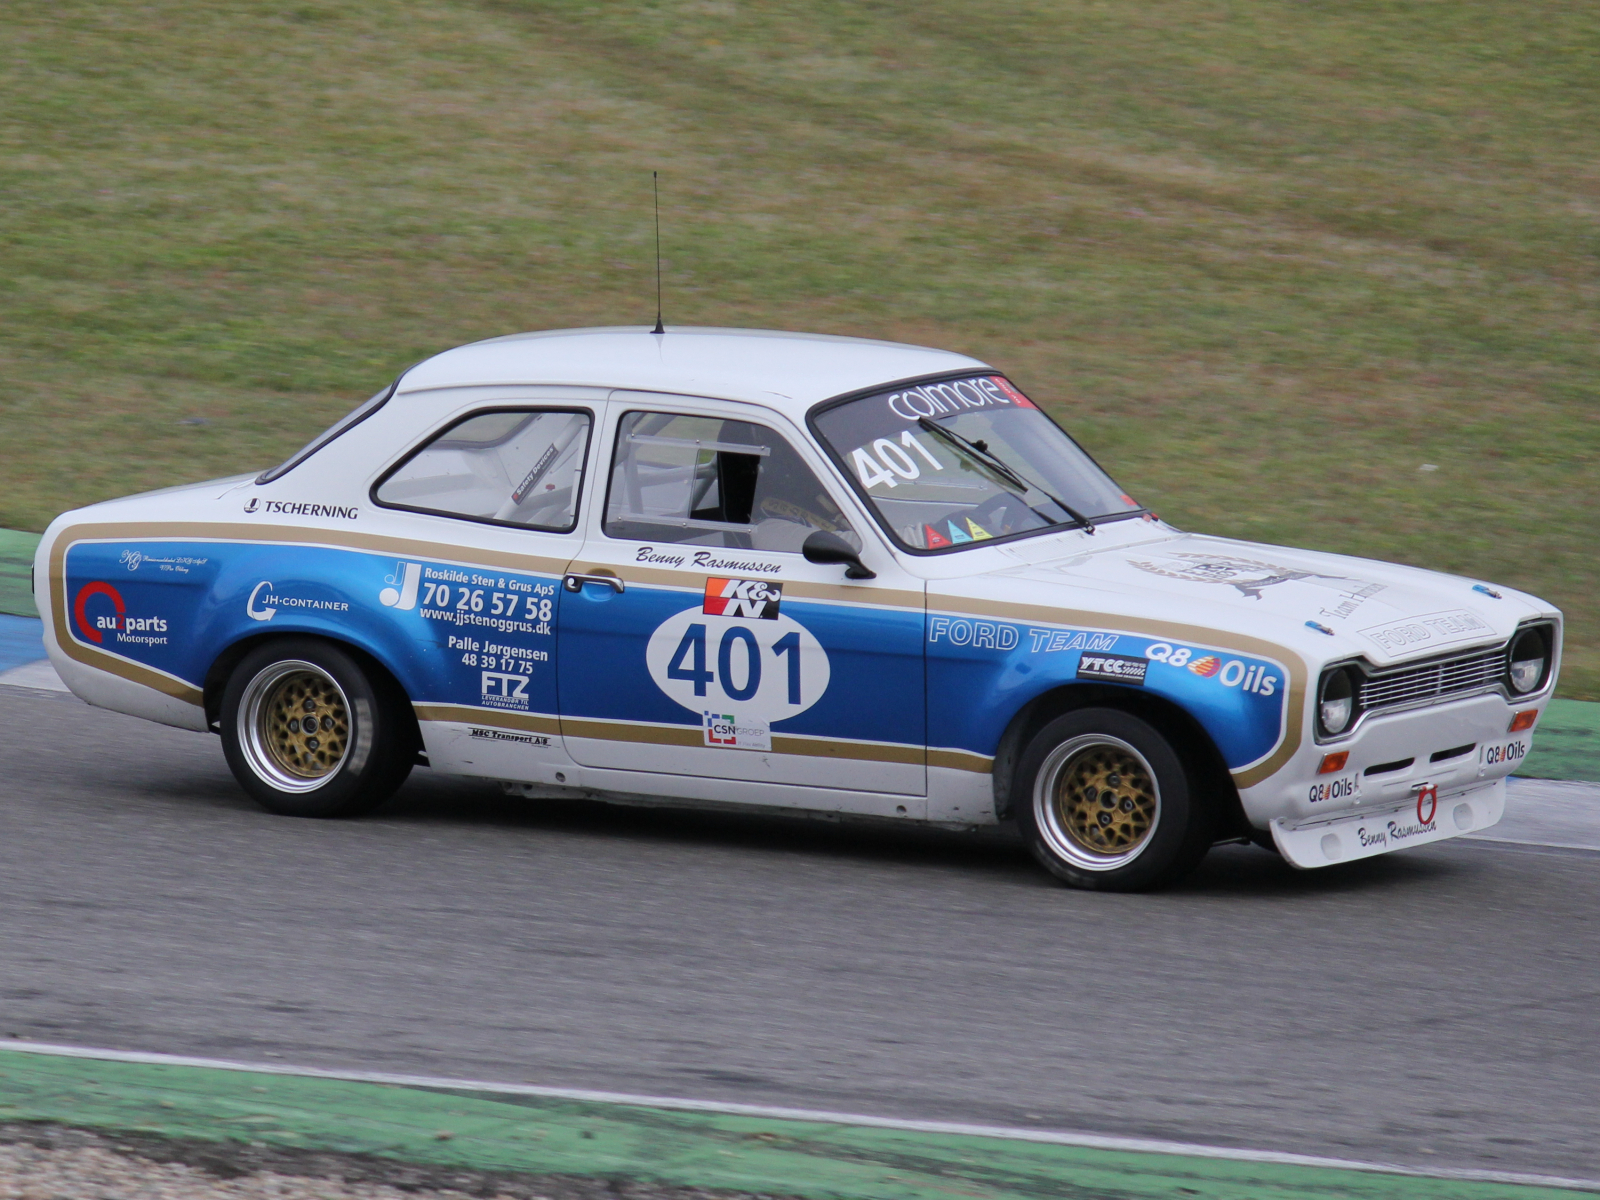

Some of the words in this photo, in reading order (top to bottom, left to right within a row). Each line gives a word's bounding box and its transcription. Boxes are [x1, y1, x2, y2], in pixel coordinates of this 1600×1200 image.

[888, 378, 1011, 420] colmore
[516, 472, 534, 495] Safety
[532, 447, 554, 474] Devices
[852, 430, 944, 489] 401
[265, 500, 359, 520] TSCHERNING
[635, 546, 685, 568] Benny
[691, 551, 782, 574] Rasmussen
[424, 567, 469, 583] Roskilde
[471, 574, 495, 588] Sten
[497, 577, 506, 589] &
[508, 580, 532, 593] Grus
[533, 583, 555, 597] ApS
[422, 582, 450, 607] 70
[456, 587, 484, 612] 26
[490, 592, 519, 617] 57
[524, 597, 553, 622] 58
[96, 612, 168, 634] au2parts
[419, 608, 552, 635] www.jjstenoggrus.dk
[929, 616, 1020, 651] FORD
[1028, 628, 1120, 654] TEAM
[1369, 623, 1432, 650] FORD
[1422, 613, 1486, 636] TEAM
[116, 633, 168, 646] Motorsport
[448, 635, 480, 652] Palle
[483, 640, 548, 661] Jørgensen
[461, 653, 478, 666] 48
[480, 655, 497, 669] 39
[500, 658, 515, 671] 17
[518, 660, 534, 675] 75
[666, 622, 802, 705] 401
[1079, 656, 1125, 674] YTCC
[1144, 642, 1192, 668] Q8
[1219, 660, 1278, 697] Oils
[481, 670, 530, 699] FTZ
[481, 700, 530, 711] AUTOBRANCHEN
[492, 731, 533, 743] Transport
[713, 724, 736, 735] CSN
[736, 727, 765, 737] GROEP
[1487, 745, 1501, 765] Q8
[1506, 740, 1525, 761] Oils
[1309, 783, 1325, 803] Q8
[1331, 777, 1353, 799] Oils
[1357, 827, 1387, 847] Benny
[1387, 820, 1437, 840] Rasmussen
